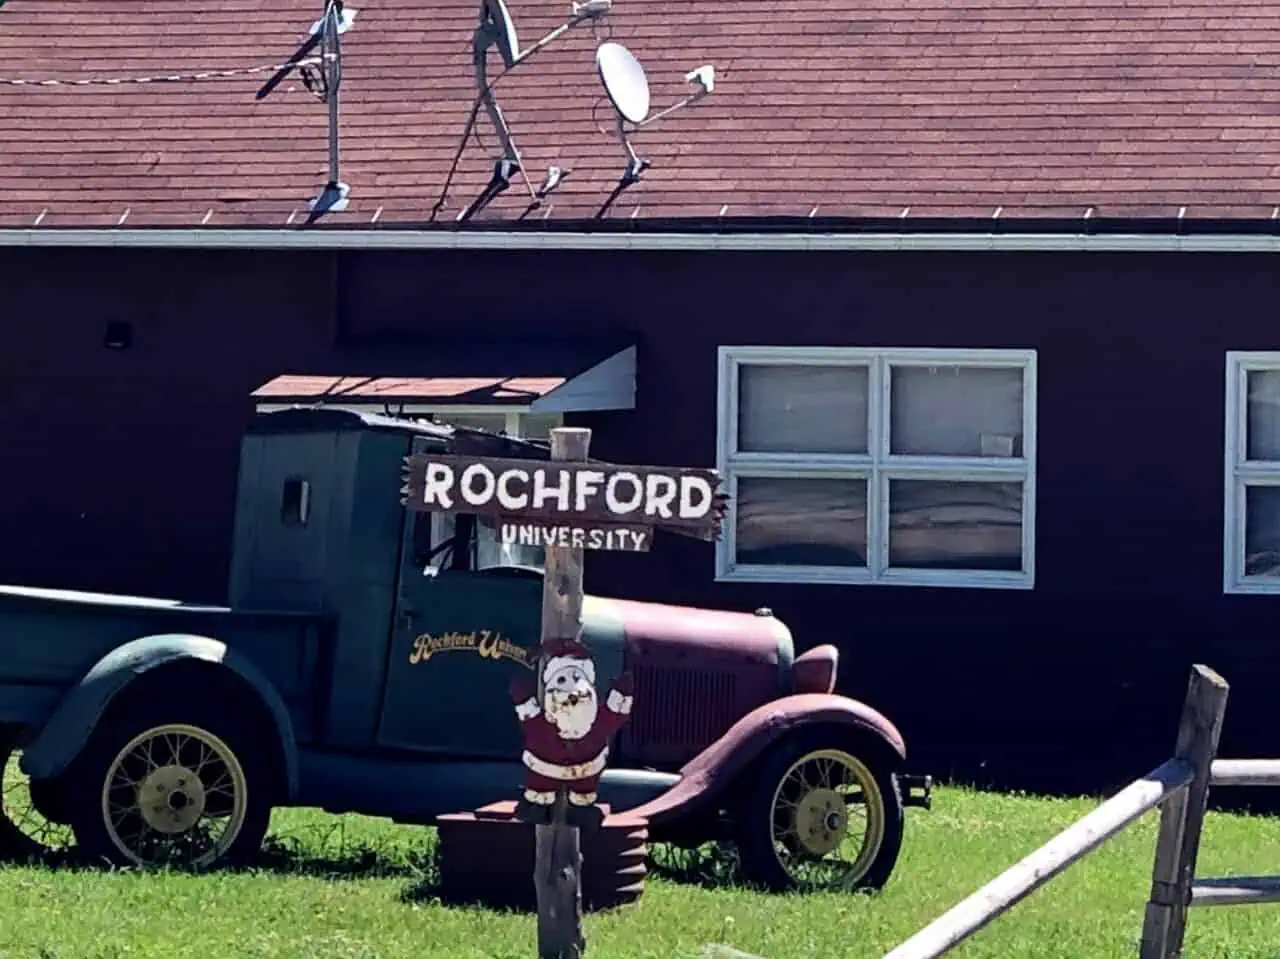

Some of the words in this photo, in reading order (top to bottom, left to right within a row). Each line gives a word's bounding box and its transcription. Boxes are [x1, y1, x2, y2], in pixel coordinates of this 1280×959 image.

[424, 462, 713, 518] ROCHFORD
[502, 524, 645, 551] UNIVERSITY
[409, 631, 476, 664] Rochford
